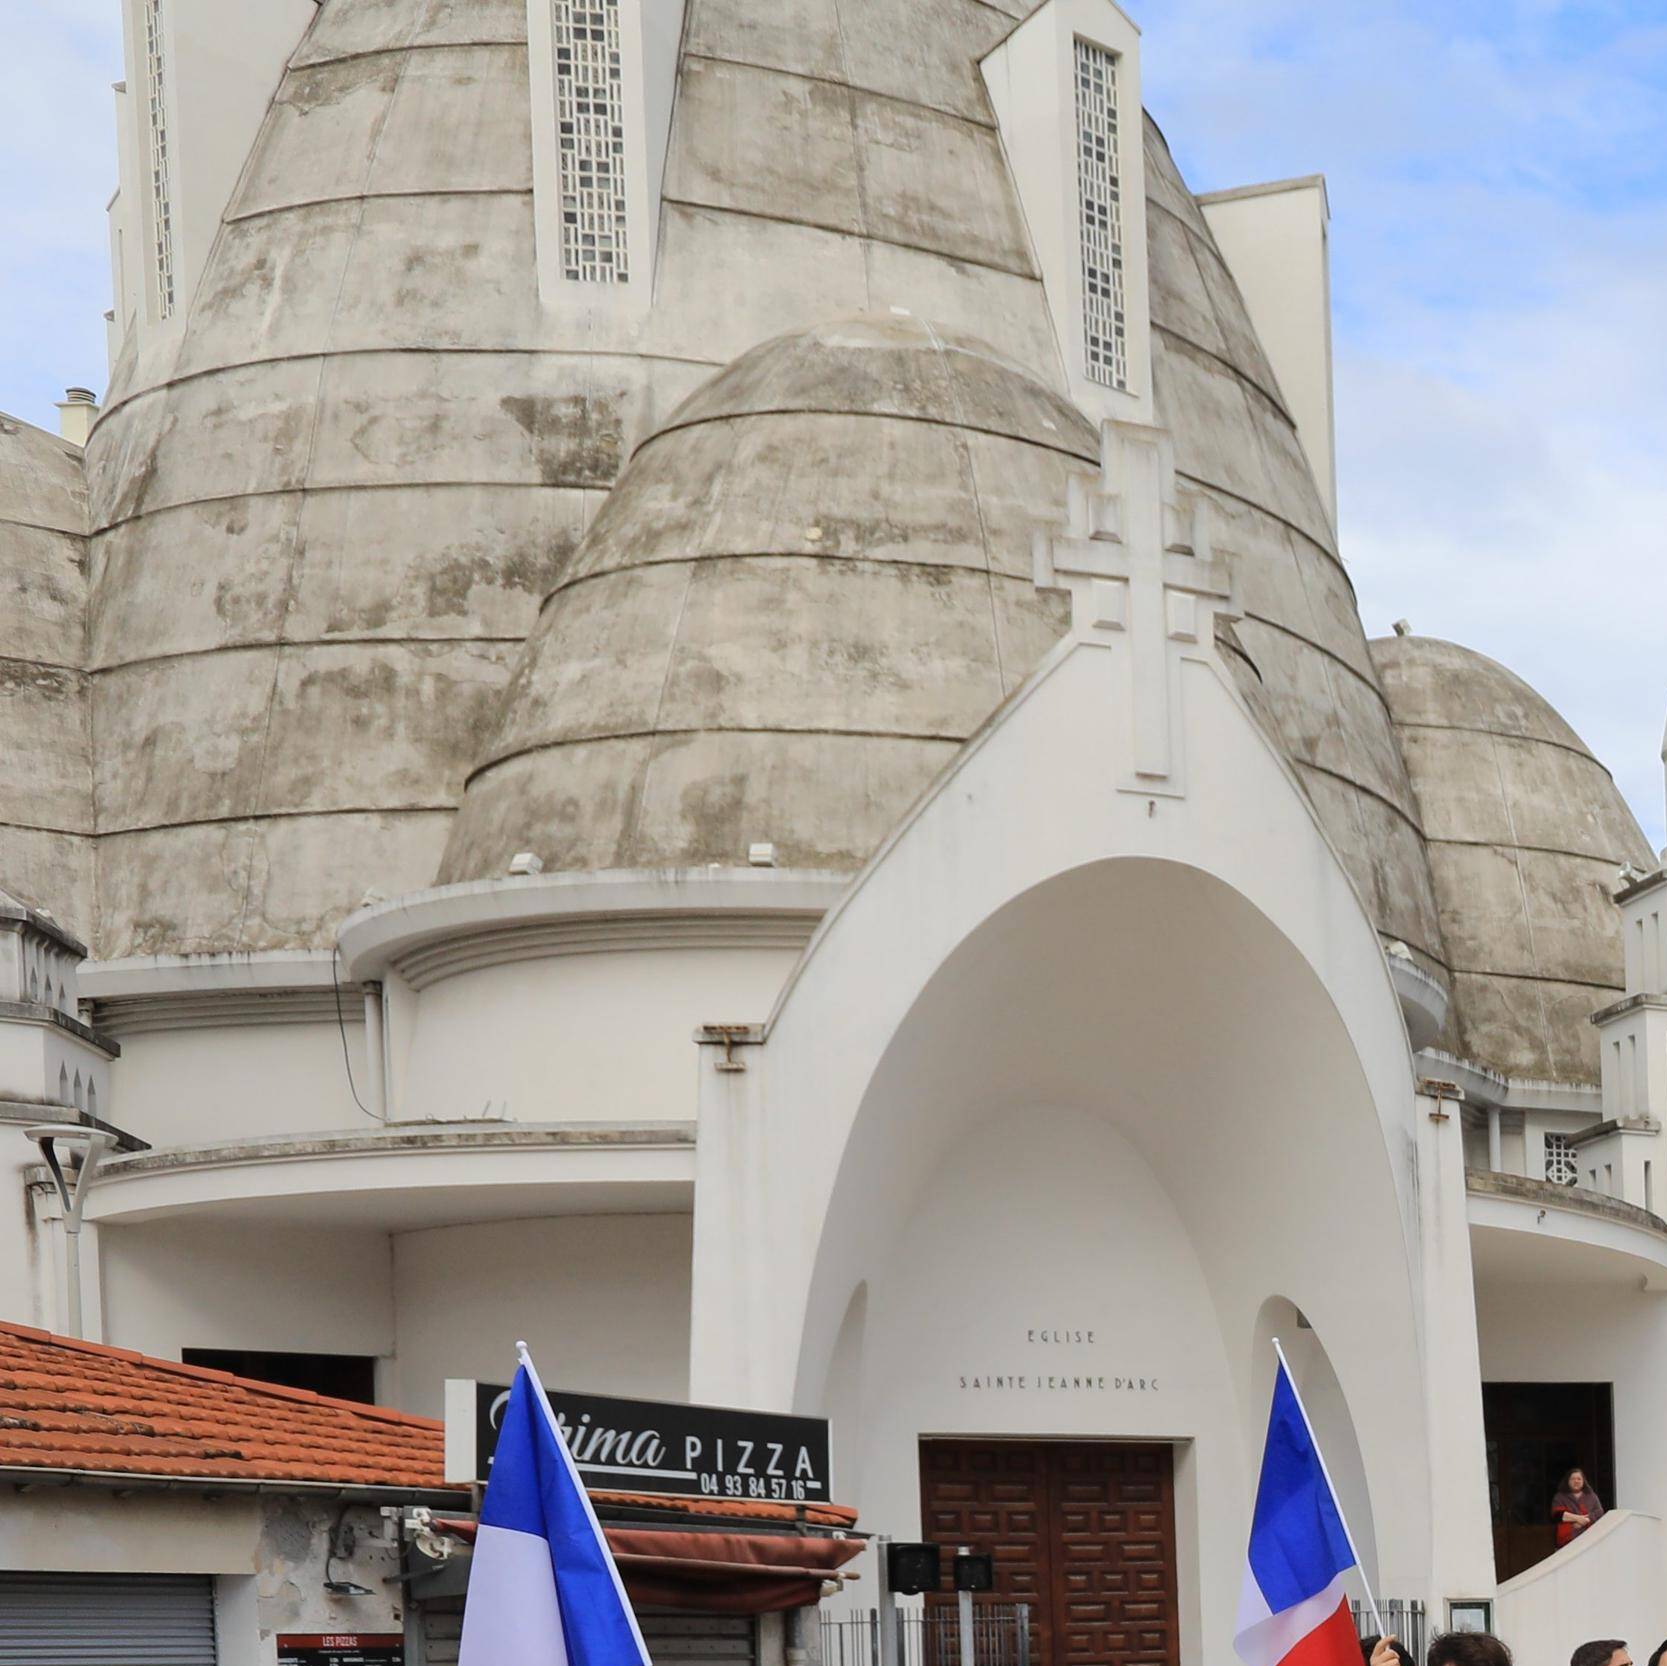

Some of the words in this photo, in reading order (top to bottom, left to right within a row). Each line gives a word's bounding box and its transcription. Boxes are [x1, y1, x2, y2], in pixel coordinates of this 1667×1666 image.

[1027, 1330, 1094, 1344] EGLISE
[959, 1376, 1025, 1389] SAINTE
[1037, 1376, 1104, 1389] JEANNE
[1115, 1377, 1159, 1391] D'ARC
[489, 1389, 666, 1468] rima
[685, 1435, 815, 1479] PIZZA
[700, 1475, 718, 1495] 04
[725, 1476, 742, 1496] 93
[749, 1477, 766, 1497] 84
[771, 1479, 786, 1499] 57
[792, 1480, 805, 1500] 16
[322, 1636, 334, 1647] LES
[335, 1636, 358, 1647] PIZZAS
